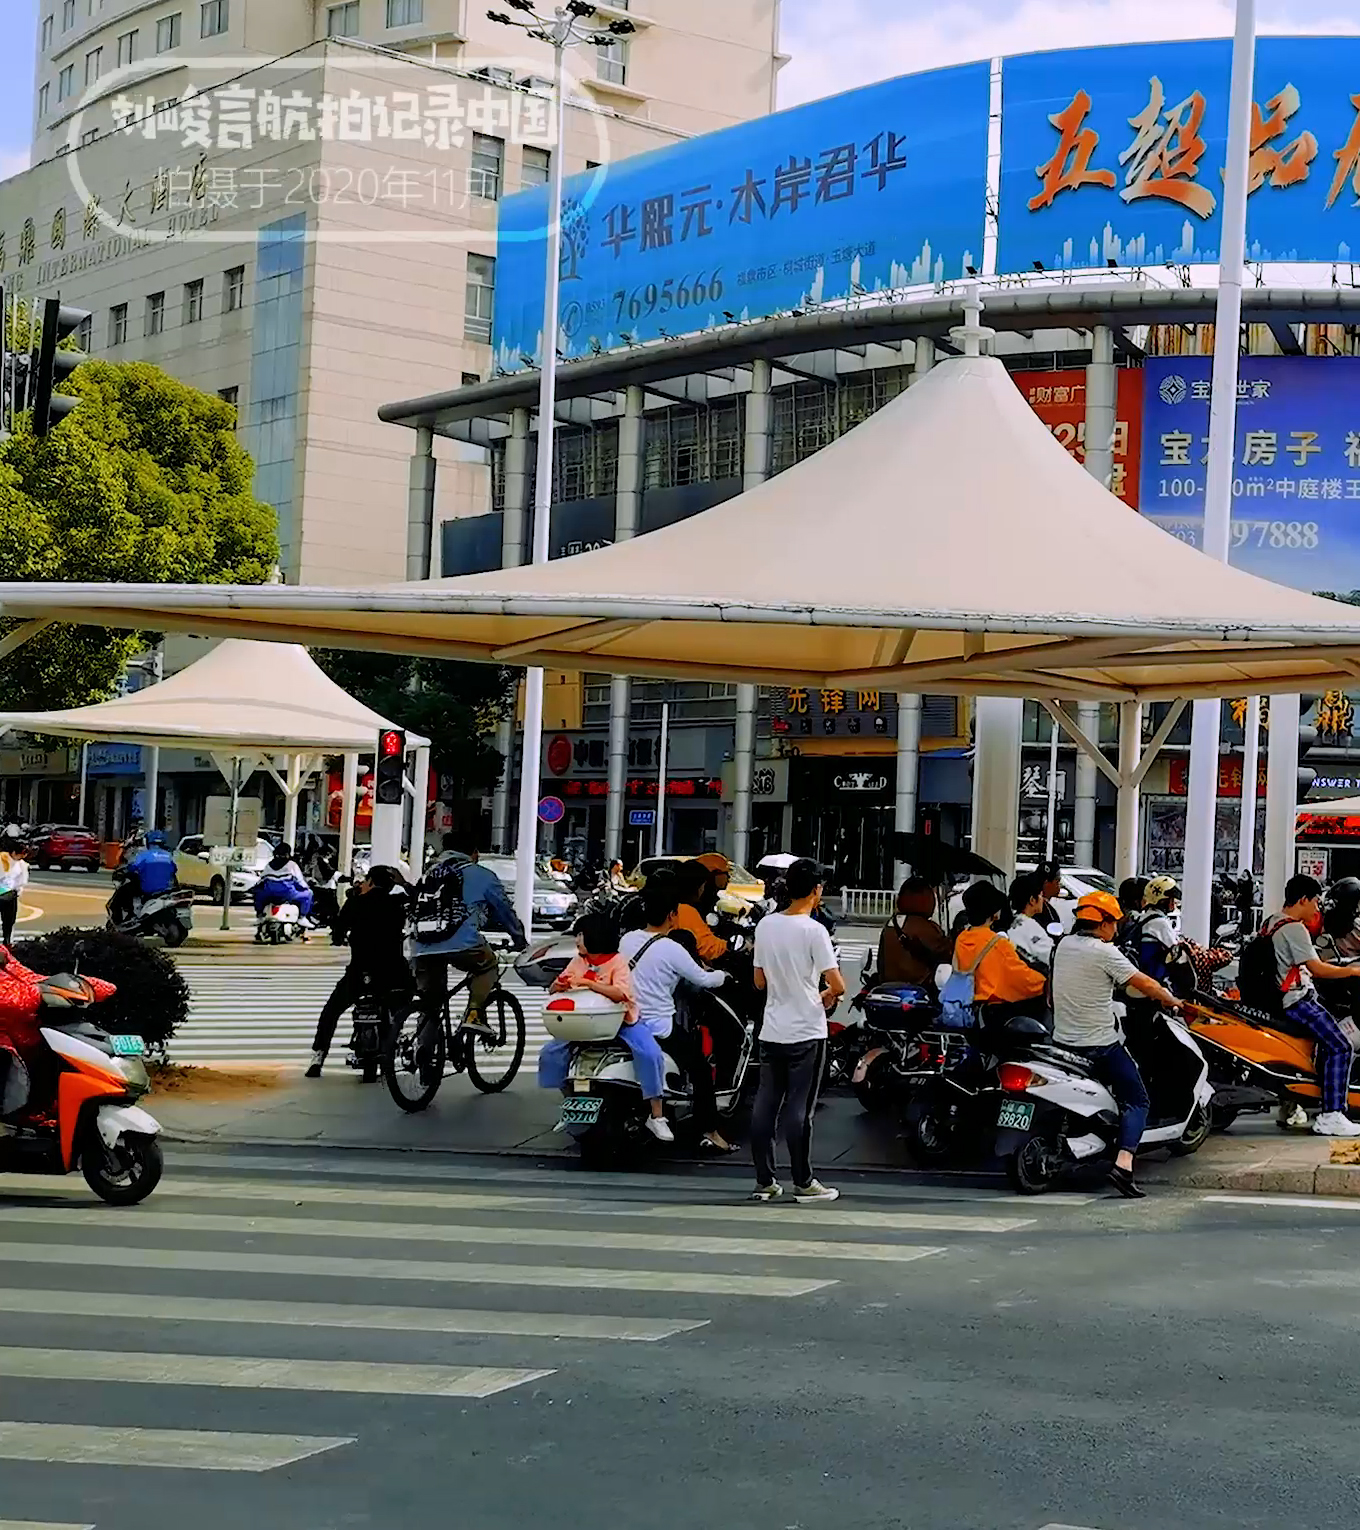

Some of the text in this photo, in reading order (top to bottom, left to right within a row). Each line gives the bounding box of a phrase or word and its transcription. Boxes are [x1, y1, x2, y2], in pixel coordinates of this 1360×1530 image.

[0, 152, 209, 272] 鼎國際大酒店
[166, 203, 219, 239] HOTEL
[612, 265, 724, 325] 7695666
[1191, 380, 1272, 399] 宝世家
[1160, 430, 1321, 468] 宝房子
[1311, 777, 1351, 788] NSWER
